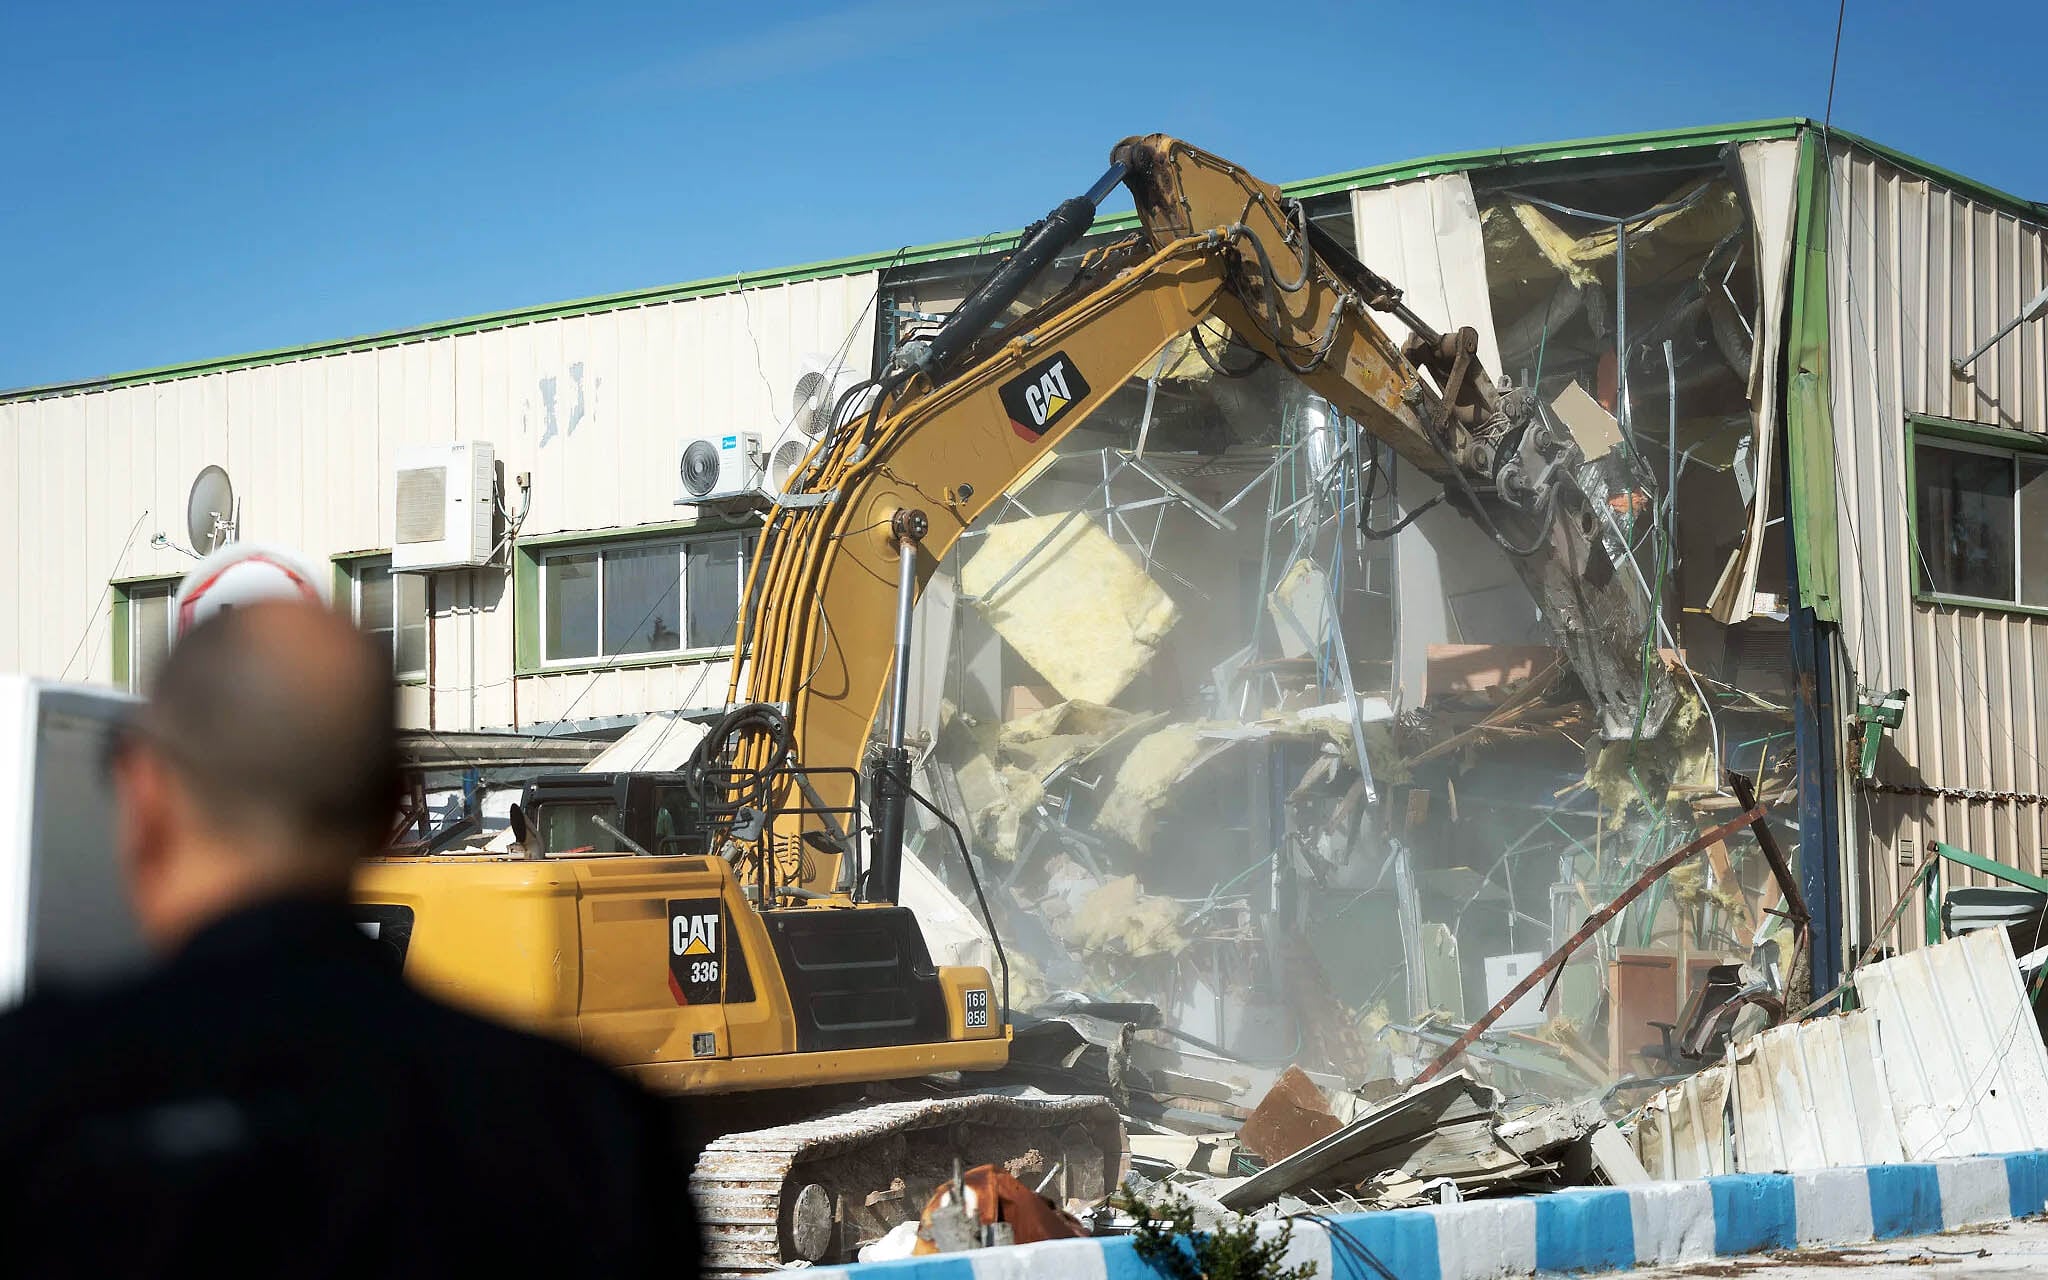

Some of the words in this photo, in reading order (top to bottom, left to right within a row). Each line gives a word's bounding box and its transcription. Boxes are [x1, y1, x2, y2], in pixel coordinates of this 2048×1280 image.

[1025, 360, 1072, 426] CAT
[672, 914, 719, 956] CAT
[690, 961, 719, 983] 336
[967, 992, 986, 1008] 168
[967, 1010, 986, 1025] 858
